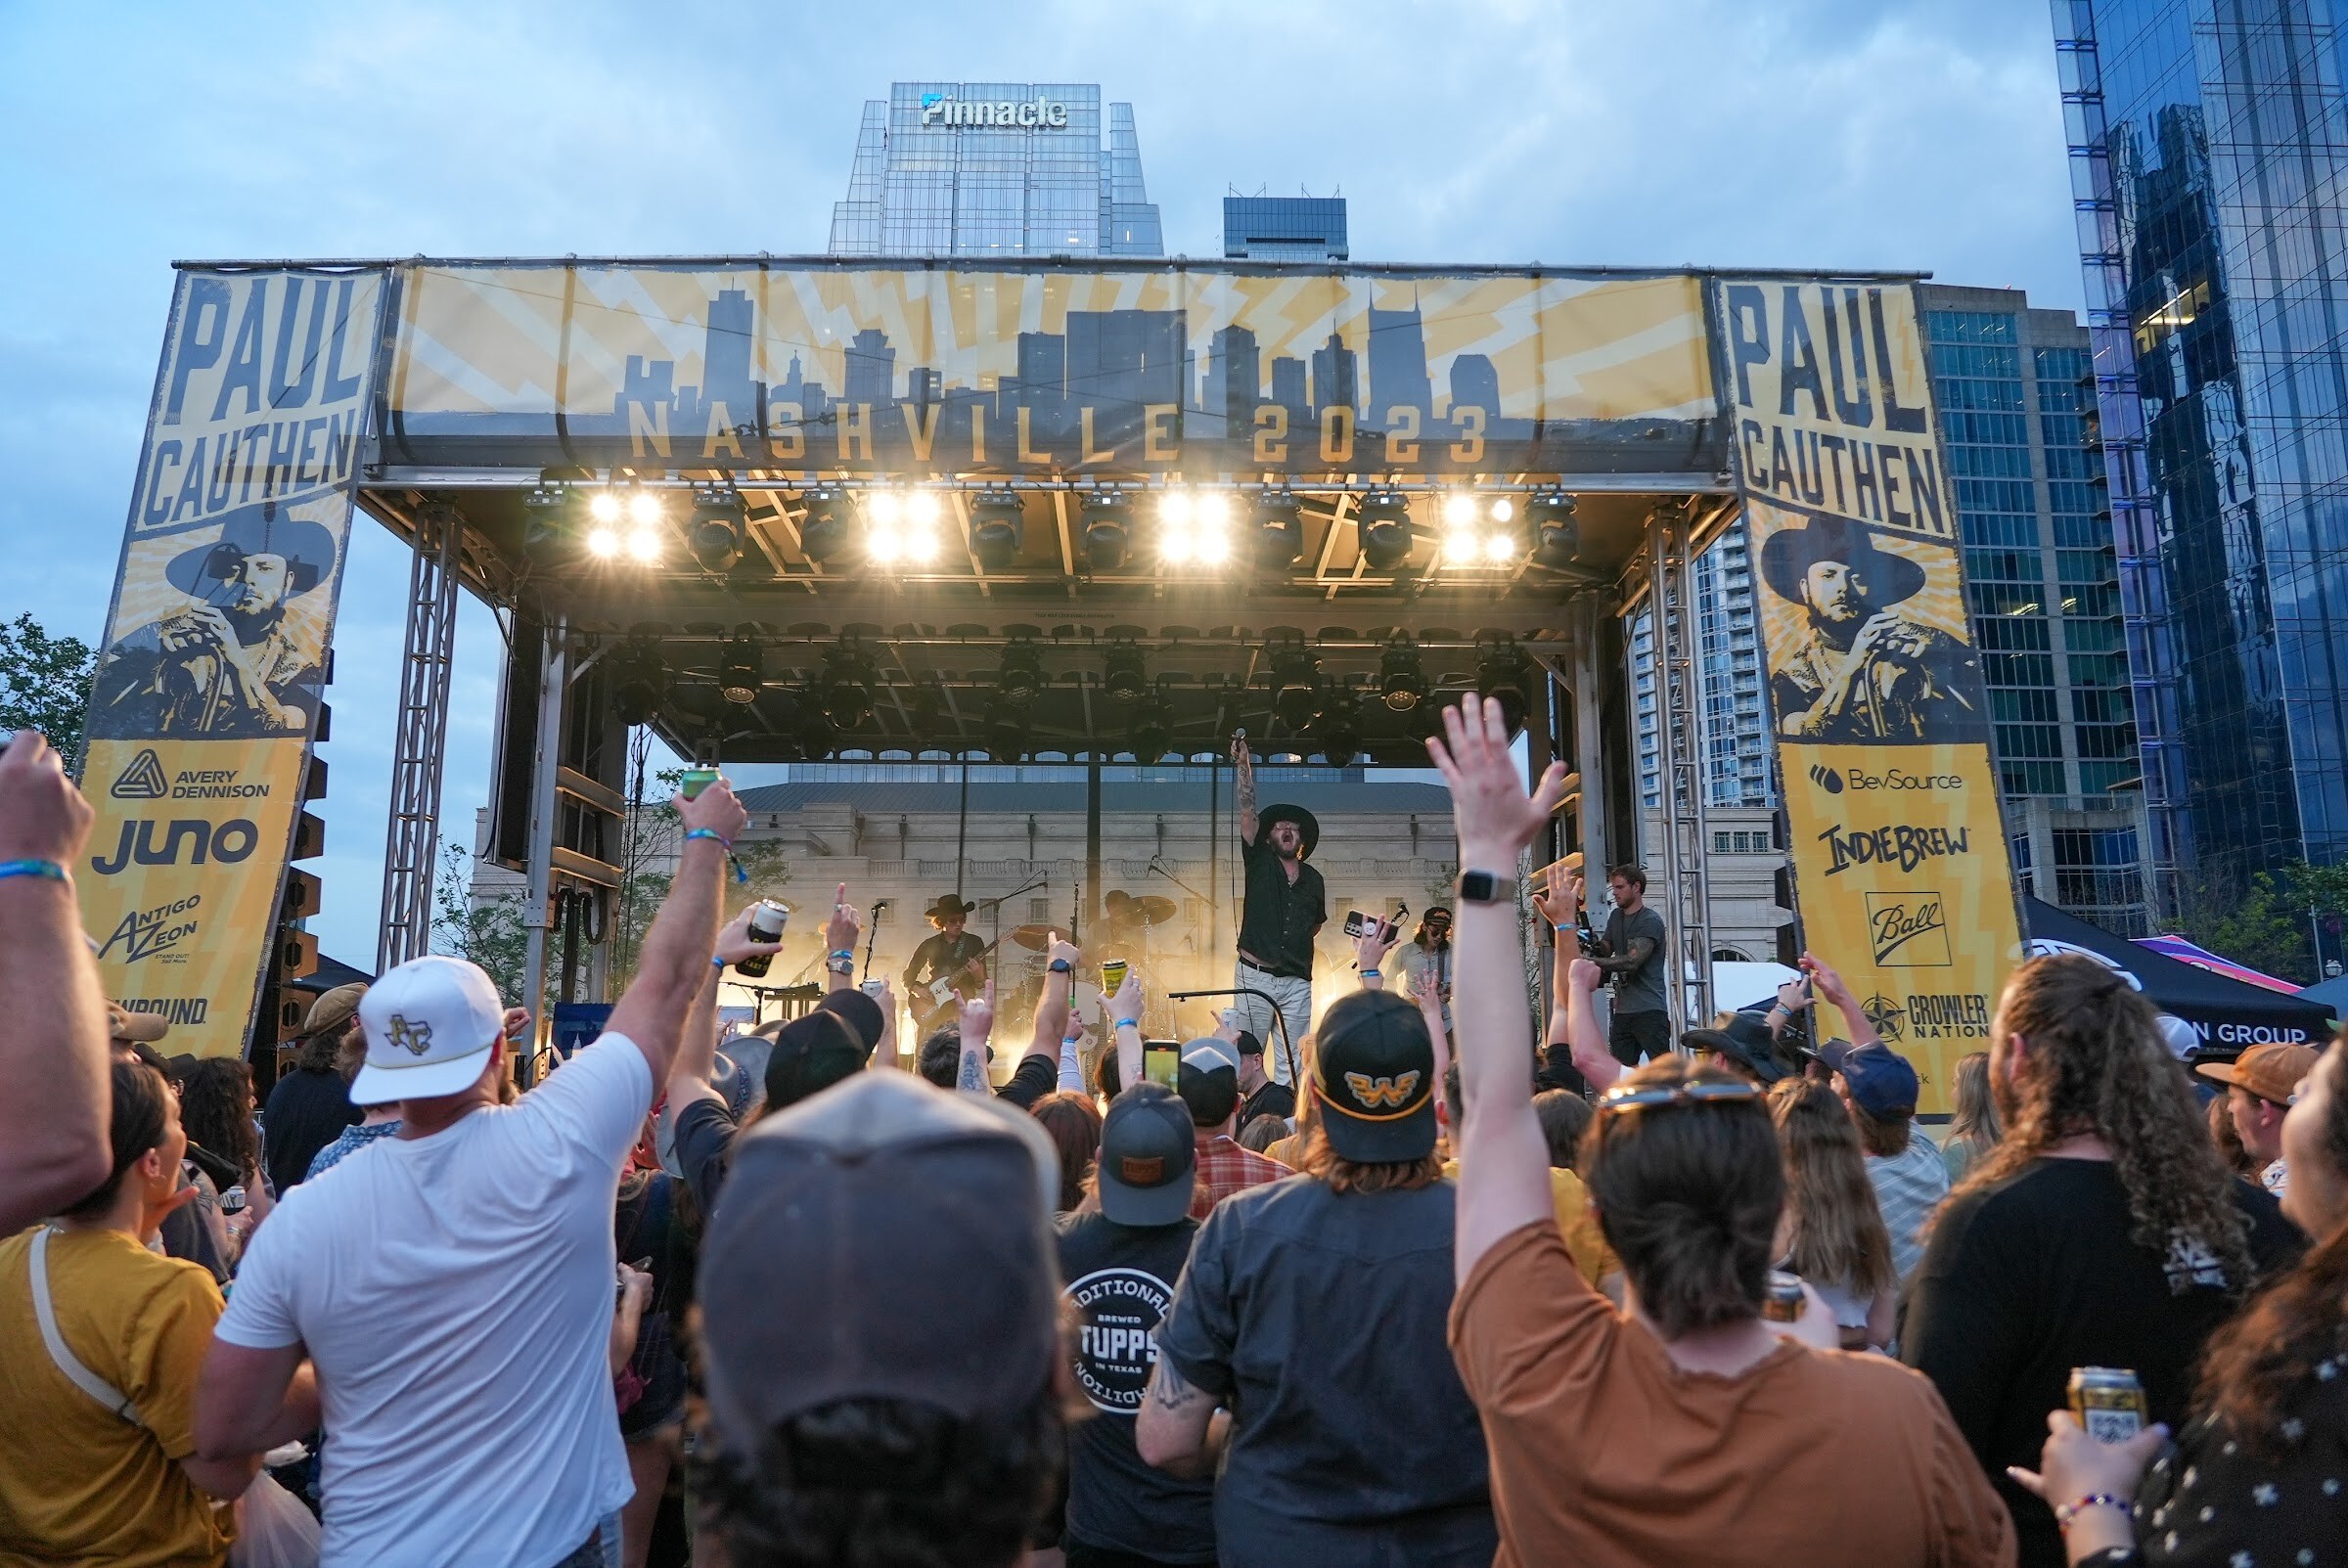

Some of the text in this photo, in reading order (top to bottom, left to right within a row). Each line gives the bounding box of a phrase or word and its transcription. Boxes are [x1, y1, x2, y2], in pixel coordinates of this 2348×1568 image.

[922, 93, 1067, 126] Pinnacle
[162, 277, 363, 426] PAUL
[1726, 285, 1927, 434] PAUL
[627, 399, 1487, 464] NASHVILLE 2023
[143, 408, 357, 526] CAUTHEN
[1740, 418, 1946, 534] CAUTHEN
[171, 784, 270, 799] DENNISON
[175, 770, 239, 784] AVERY
[1848, 769, 1963, 790] BevSource
[1872, 902, 1939, 945] Ball
[1907, 994, 1989, 1025] CROWLER
[1914, 1025, 1991, 1038] NATION
[2217, 1023, 2307, 1045] GROUP
[1097, 1314, 1142, 1324] BREWED
[1079, 1324, 1162, 1364] TUPPS
[1095, 1362, 1143, 1374] IN TEXAS
